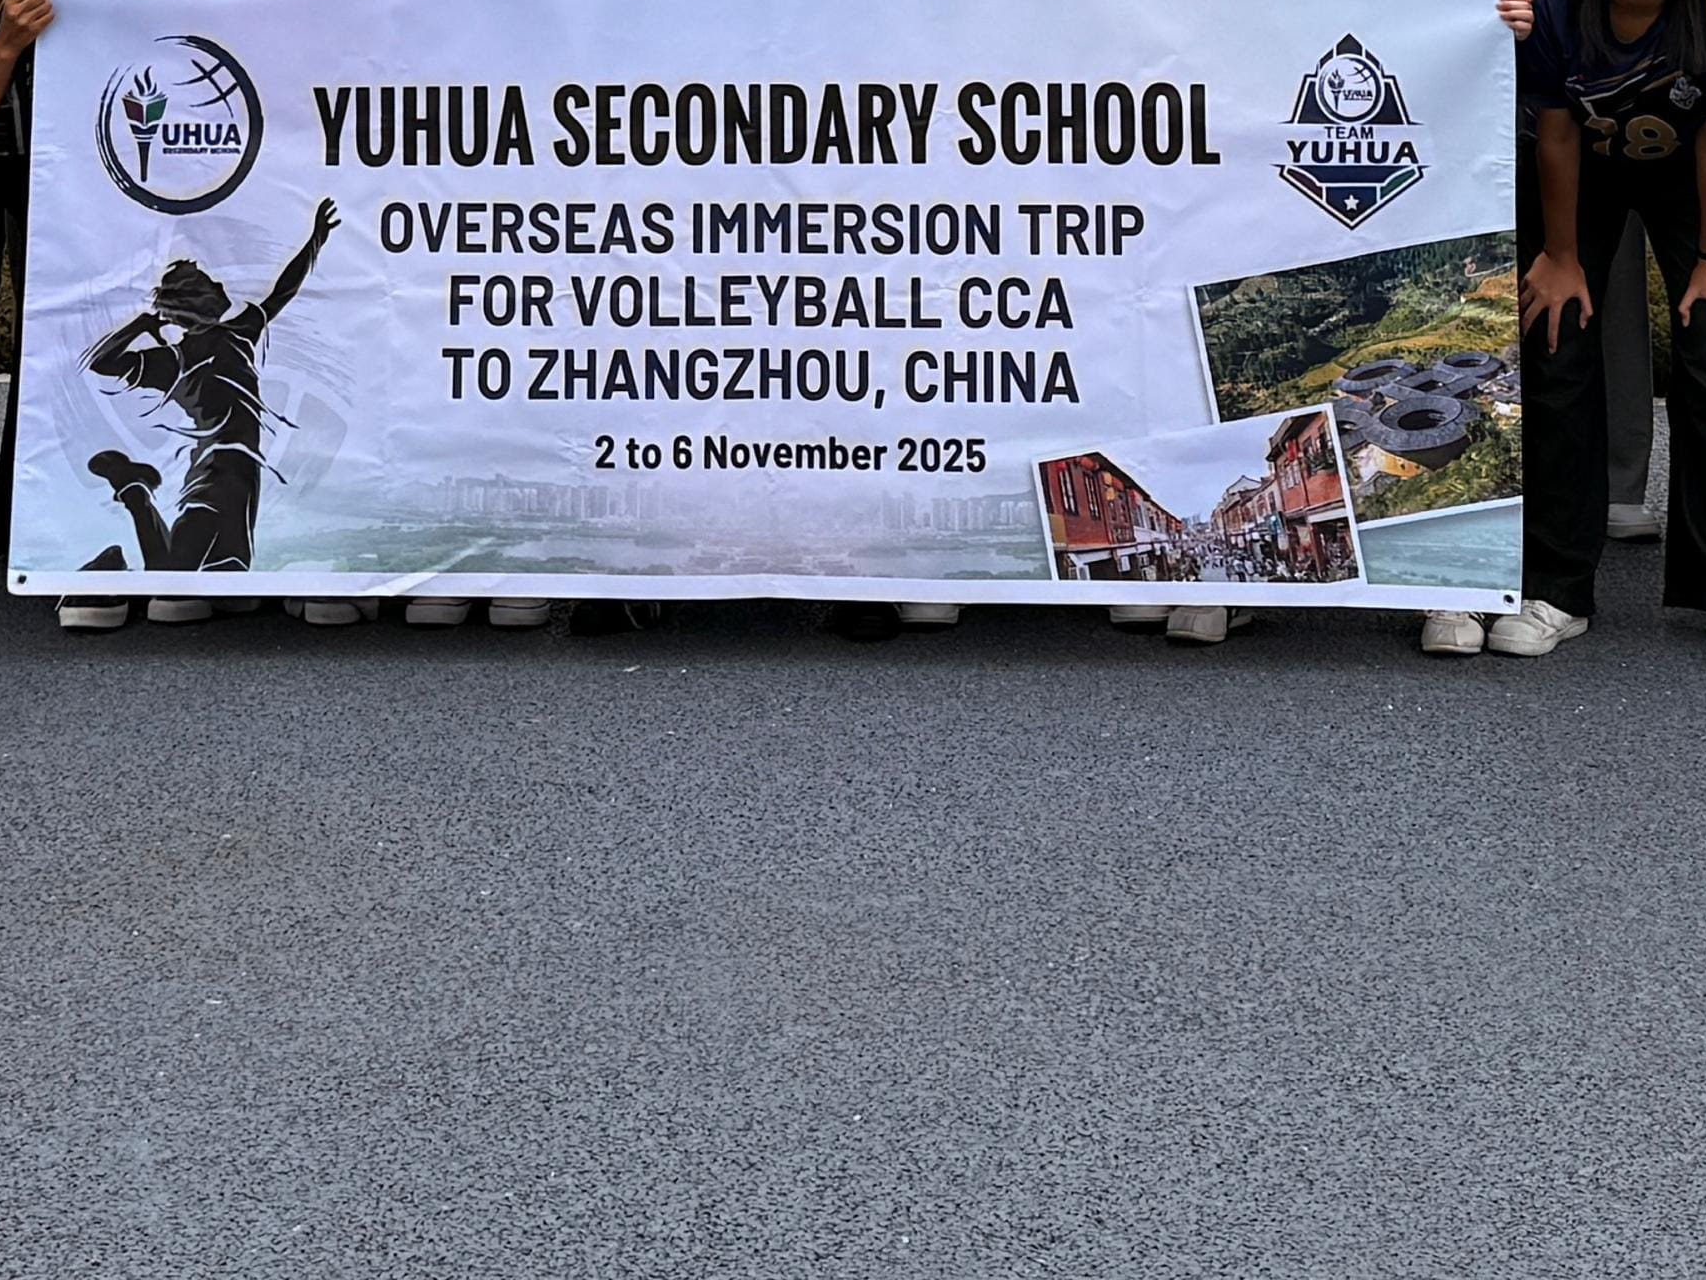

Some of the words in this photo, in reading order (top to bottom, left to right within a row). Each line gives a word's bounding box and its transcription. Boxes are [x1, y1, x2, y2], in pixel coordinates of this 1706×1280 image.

[312, 85, 535, 168] YUHUA
[553, 83, 938, 168] SECONDARY
[957, 81, 1221, 166] SCHOOL
[1324, 125, 1374, 140] TEAM
[1286, 140, 1420, 165] YUHUA
[380, 201, 674, 254] OVERSEAS
[692, 202, 1001, 256] IMMERSION
[1018, 204, 1145, 256] TRIP
[449, 274, 554, 327] FOR
[570, 275, 942, 329] VOLLEYBALL
[959, 276, 1074, 329] CCA
[441, 347, 511, 401] TO
[527, 347, 885, 410] ZHANGZHOU,
[905, 350, 1080, 404] CHINA
[595, 435, 616, 469] 2
[625, 437, 662, 470] to
[672, 436, 693, 470] 6
[703, 435, 888, 472] November
[897, 437, 986, 473] 2025
